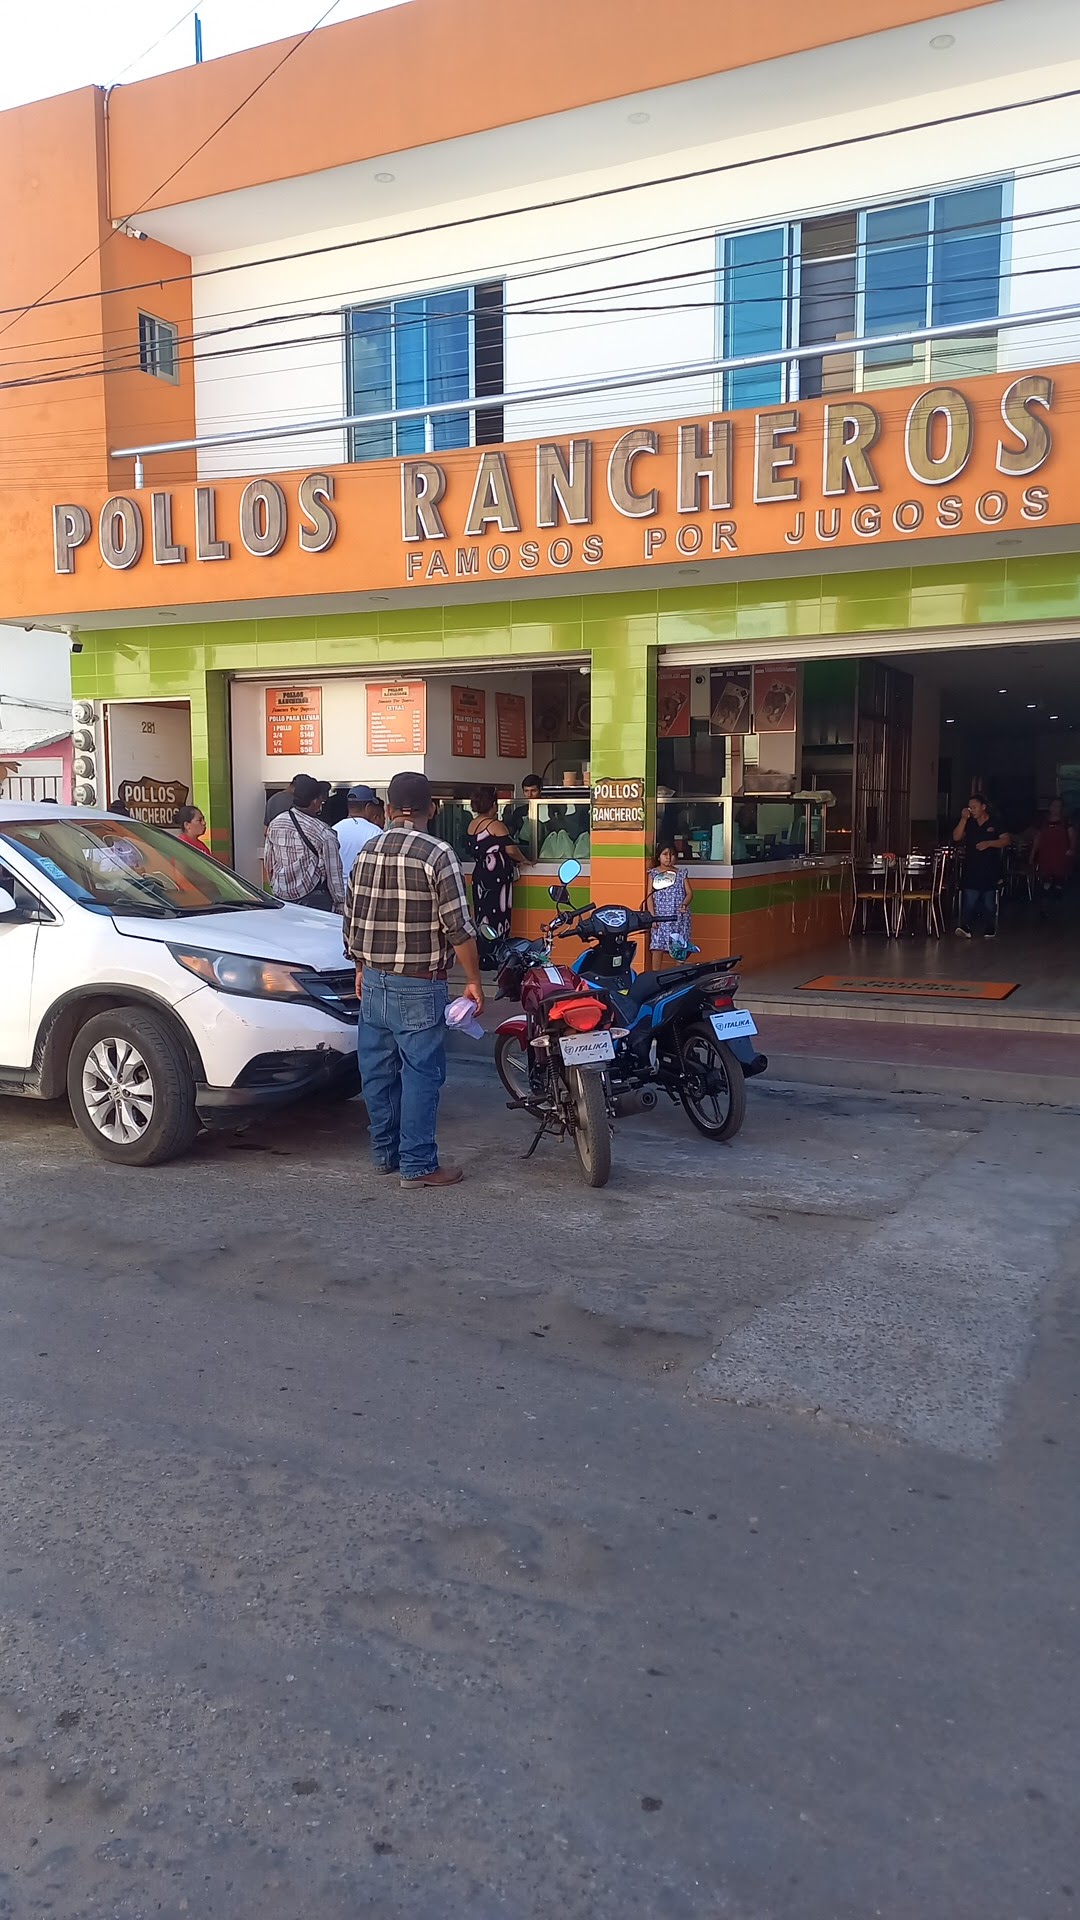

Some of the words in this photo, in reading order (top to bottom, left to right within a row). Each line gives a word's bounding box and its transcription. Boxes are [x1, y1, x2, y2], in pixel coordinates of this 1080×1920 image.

[53, 473, 337, 574] POLLOS
[401, 375, 1055, 542] RANCHEROS
[406, 534, 604, 581] FAMOSOS
[644, 520, 738, 559] POR
[785, 486, 1051, 545] JUGOSOS
[141, 721, 156, 734] 281
[125, 785, 176, 802] POLLOS
[594, 783, 639, 799] POLLOS
[125, 806, 180, 824] ANCHERO
[592, 807, 644, 821] RANCHEROS
[724, 1019, 750, 1029] ITALIKA
[574, 1041, 608, 1053] ITALIKA
